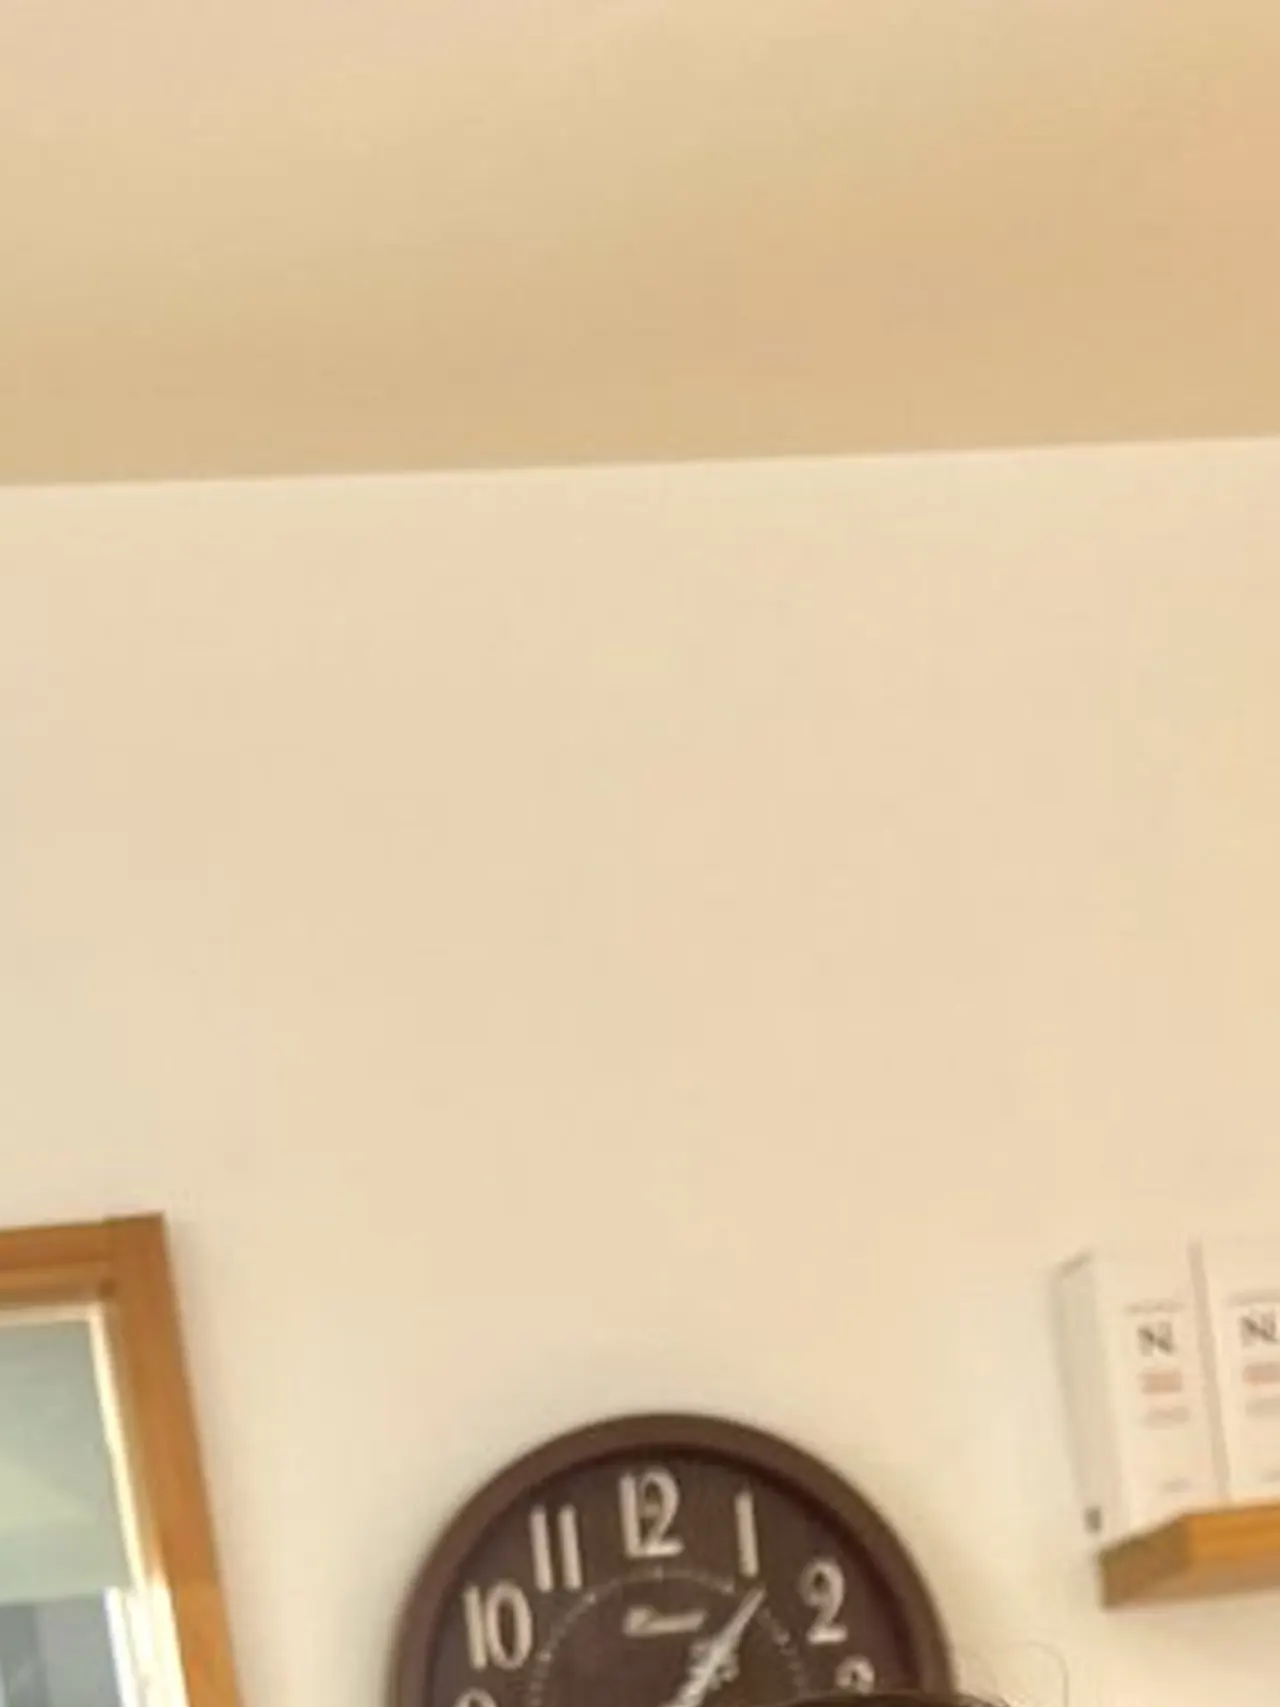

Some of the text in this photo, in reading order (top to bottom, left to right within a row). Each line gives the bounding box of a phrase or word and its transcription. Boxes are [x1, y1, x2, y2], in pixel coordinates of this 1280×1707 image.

[529, 1505, 583, 1592] 11
[621, 1467, 682, 1557] 12
[733, 1489, 758, 1577] 1
[463, 1580, 532, 1670] 10
[799, 1558, 848, 1645] 2
